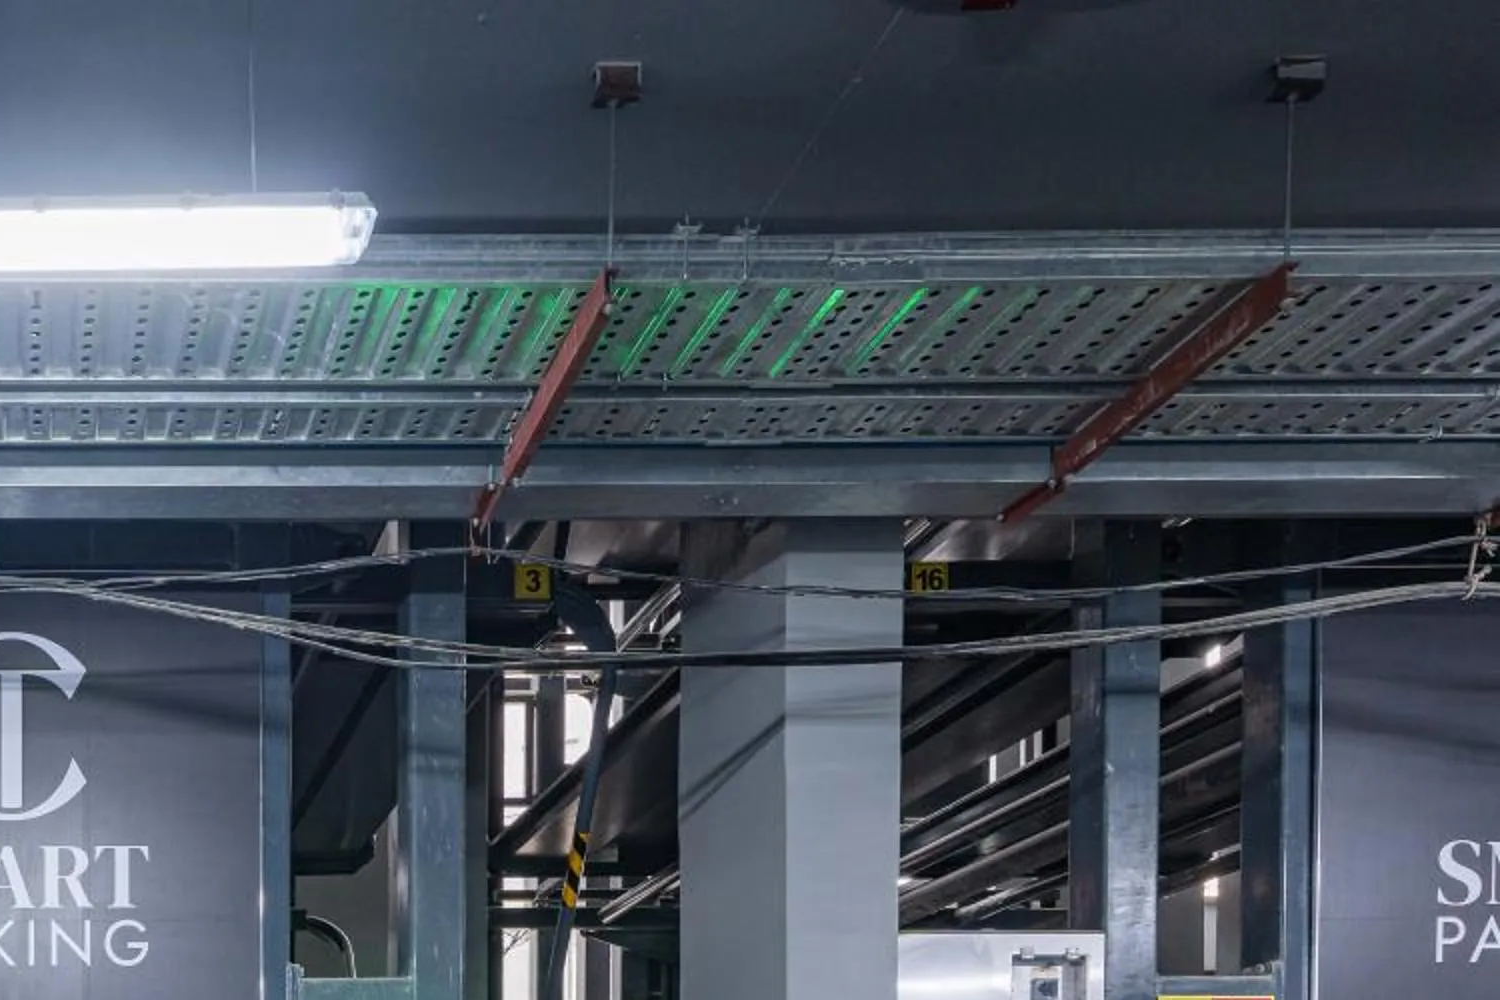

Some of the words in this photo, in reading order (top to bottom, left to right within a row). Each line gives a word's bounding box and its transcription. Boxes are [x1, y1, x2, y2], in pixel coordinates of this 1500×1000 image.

[526, 569, 541, 593] 3
[916, 568, 943, 591] 16
[1437, 839, 1500, 906] S
